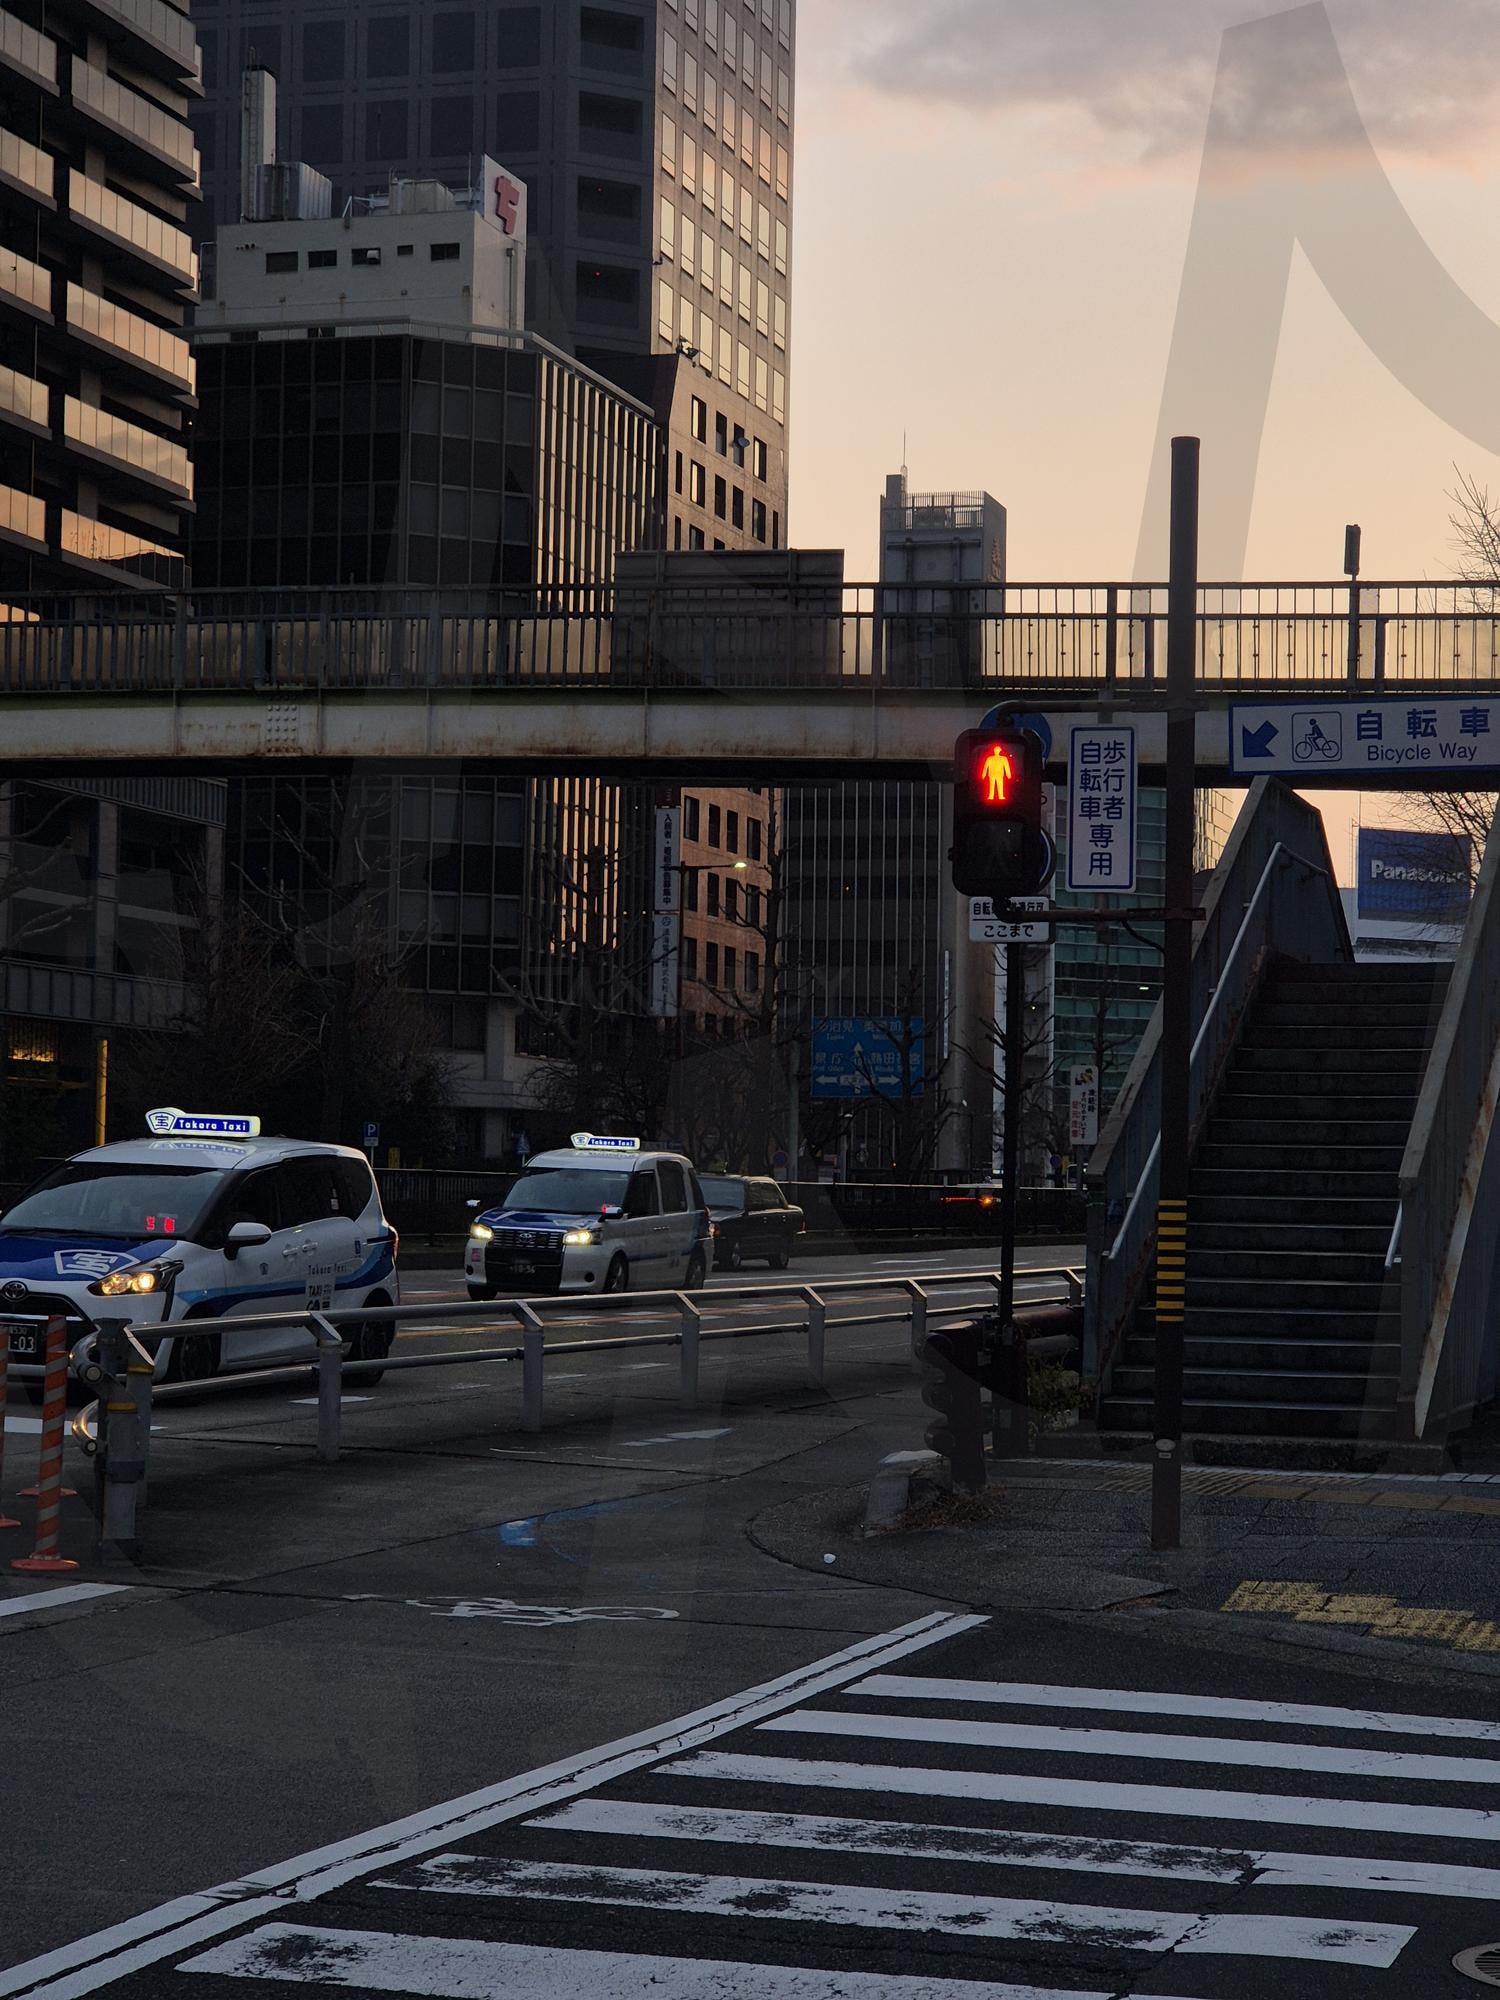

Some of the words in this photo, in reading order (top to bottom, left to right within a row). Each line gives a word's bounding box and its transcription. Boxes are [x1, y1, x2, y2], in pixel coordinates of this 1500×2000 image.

[1356, 706, 1490, 741] 自転車
[1368, 743, 1431, 764] Bicycle
[1439, 742, 1477, 762] Way
[1079, 740, 1102, 821] 自転車
[1103, 740, 1126, 820] 歩行者
[1088, 824, 1114, 876] 専用
[974, 902, 1045, 915] 自転通行可
[984, 925, 1034, 937] ここまで
[871, 1051, 921, 1065] 熱田宮
[179, 1119, 218, 1131] Takara
[222, 1120, 246, 1132] Taxi
[368, 1124, 377, 1136] P
